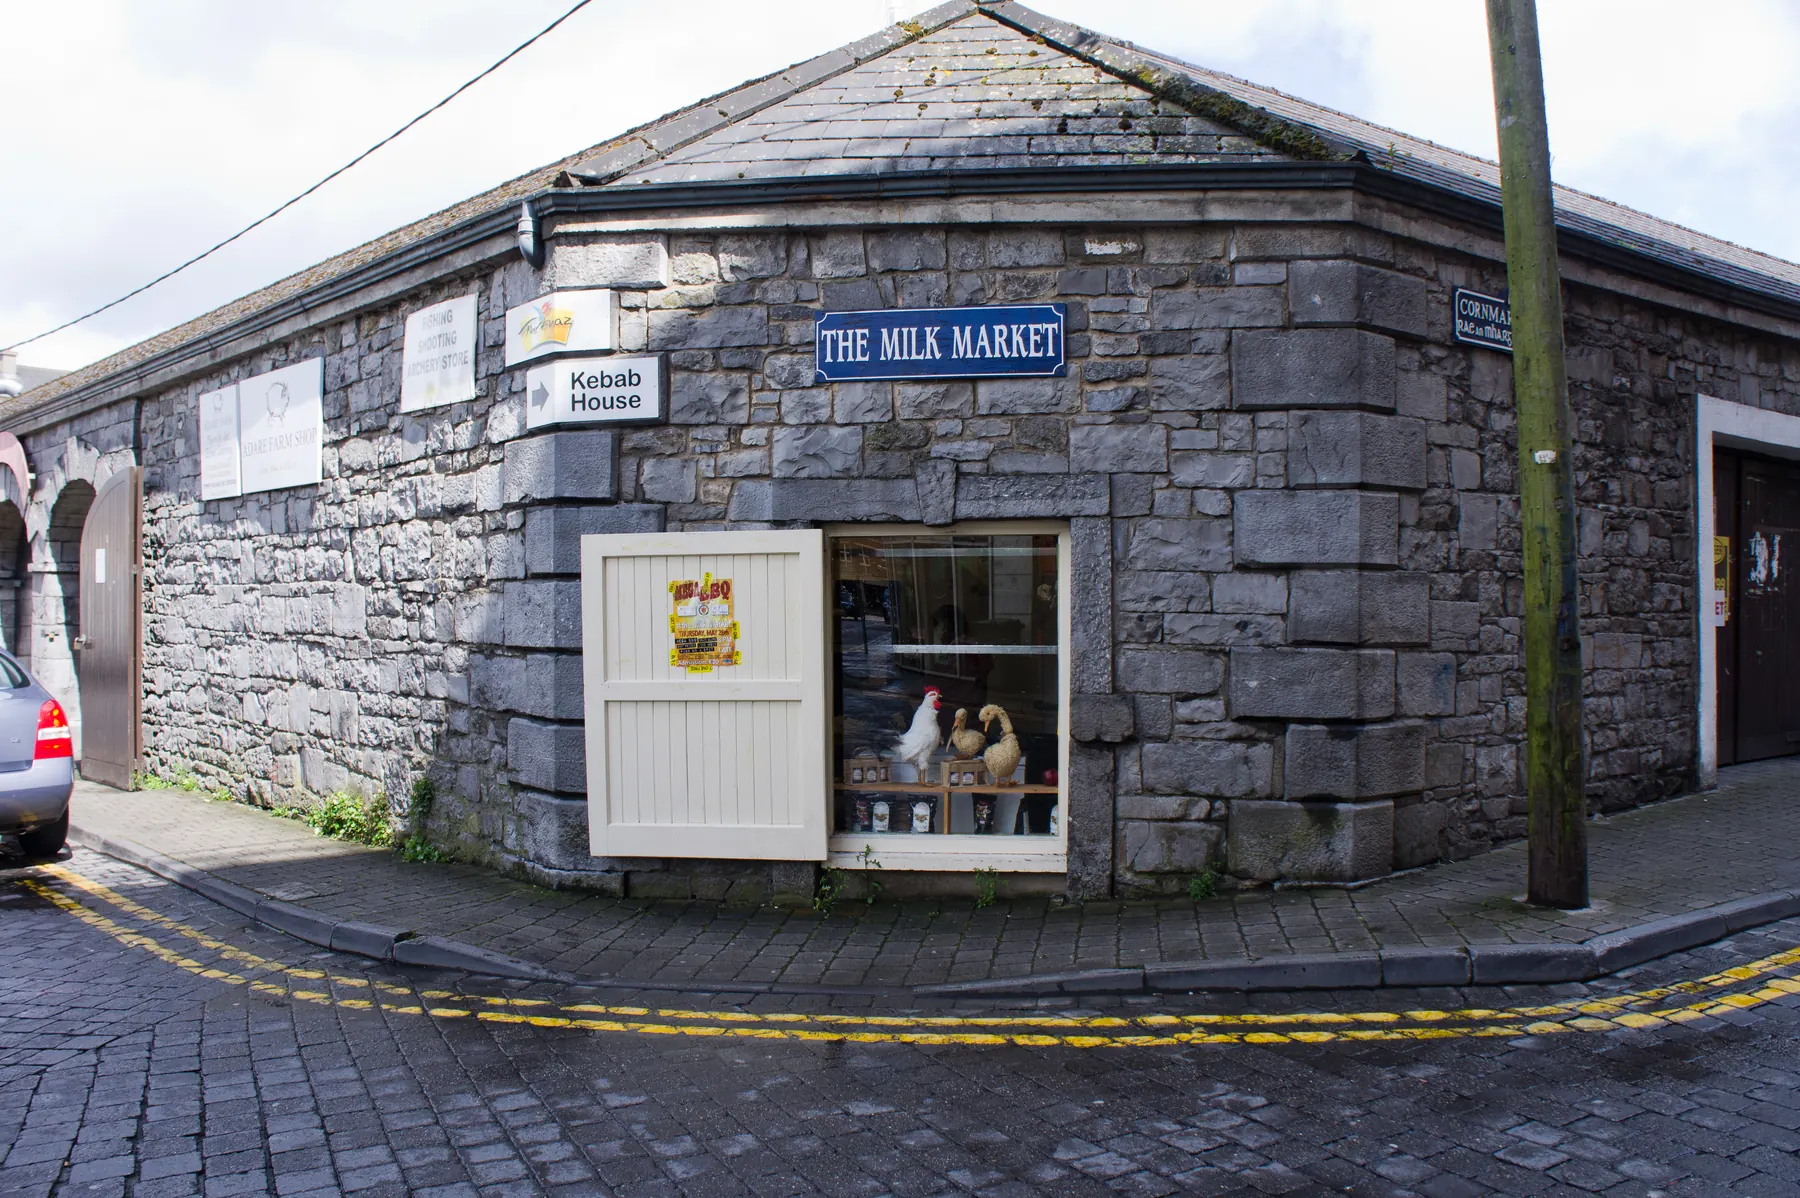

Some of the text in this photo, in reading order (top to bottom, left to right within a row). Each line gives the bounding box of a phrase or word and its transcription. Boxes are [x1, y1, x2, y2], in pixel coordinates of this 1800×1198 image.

[422, 308, 453, 331] FISHING
[418, 330, 457, 354] SHOOTING
[821, 322, 1059, 363] THE MILK MARKET
[407, 350, 469, 378] ARCHERY STORE
[571, 368, 642, 391] Kebab
[571, 393, 642, 412] House
[243, 438, 268, 458] ADARE
[269, 432, 293, 452] FARM
[294, 427, 318, 447] SHOP
[1715, 601, 1725, 615] ET
